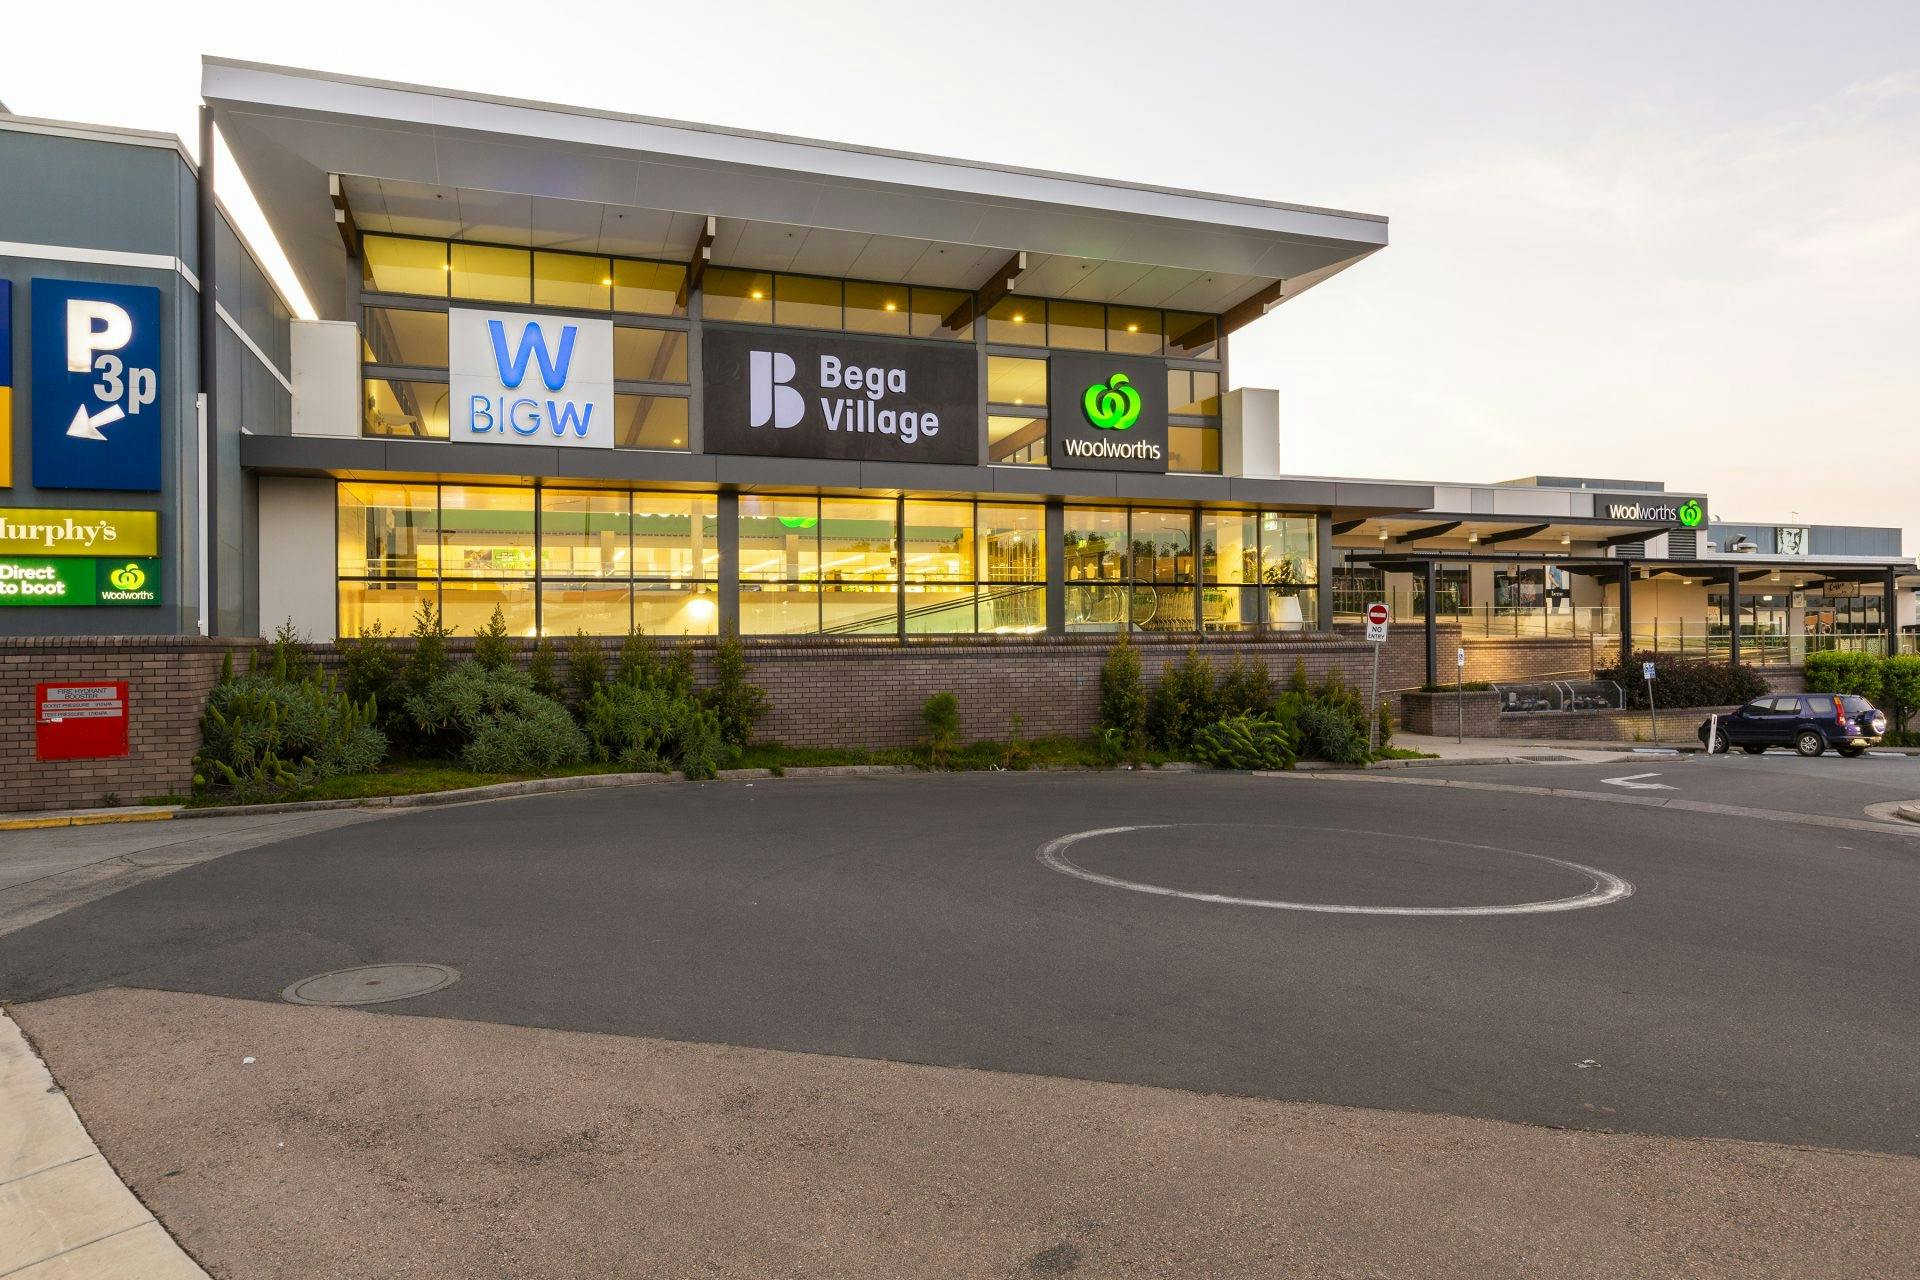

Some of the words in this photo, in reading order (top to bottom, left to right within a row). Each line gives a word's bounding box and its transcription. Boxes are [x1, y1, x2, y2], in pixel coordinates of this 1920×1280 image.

[67, 299, 132, 372] P
[487, 319, 578, 391] W
[93, 354, 157, 414] 3p
[820, 355, 906, 400] Bega
[821, 397, 939, 444] Village
[0, 564, 55, 580] Direct
[21, 580, 65, 595] boot
